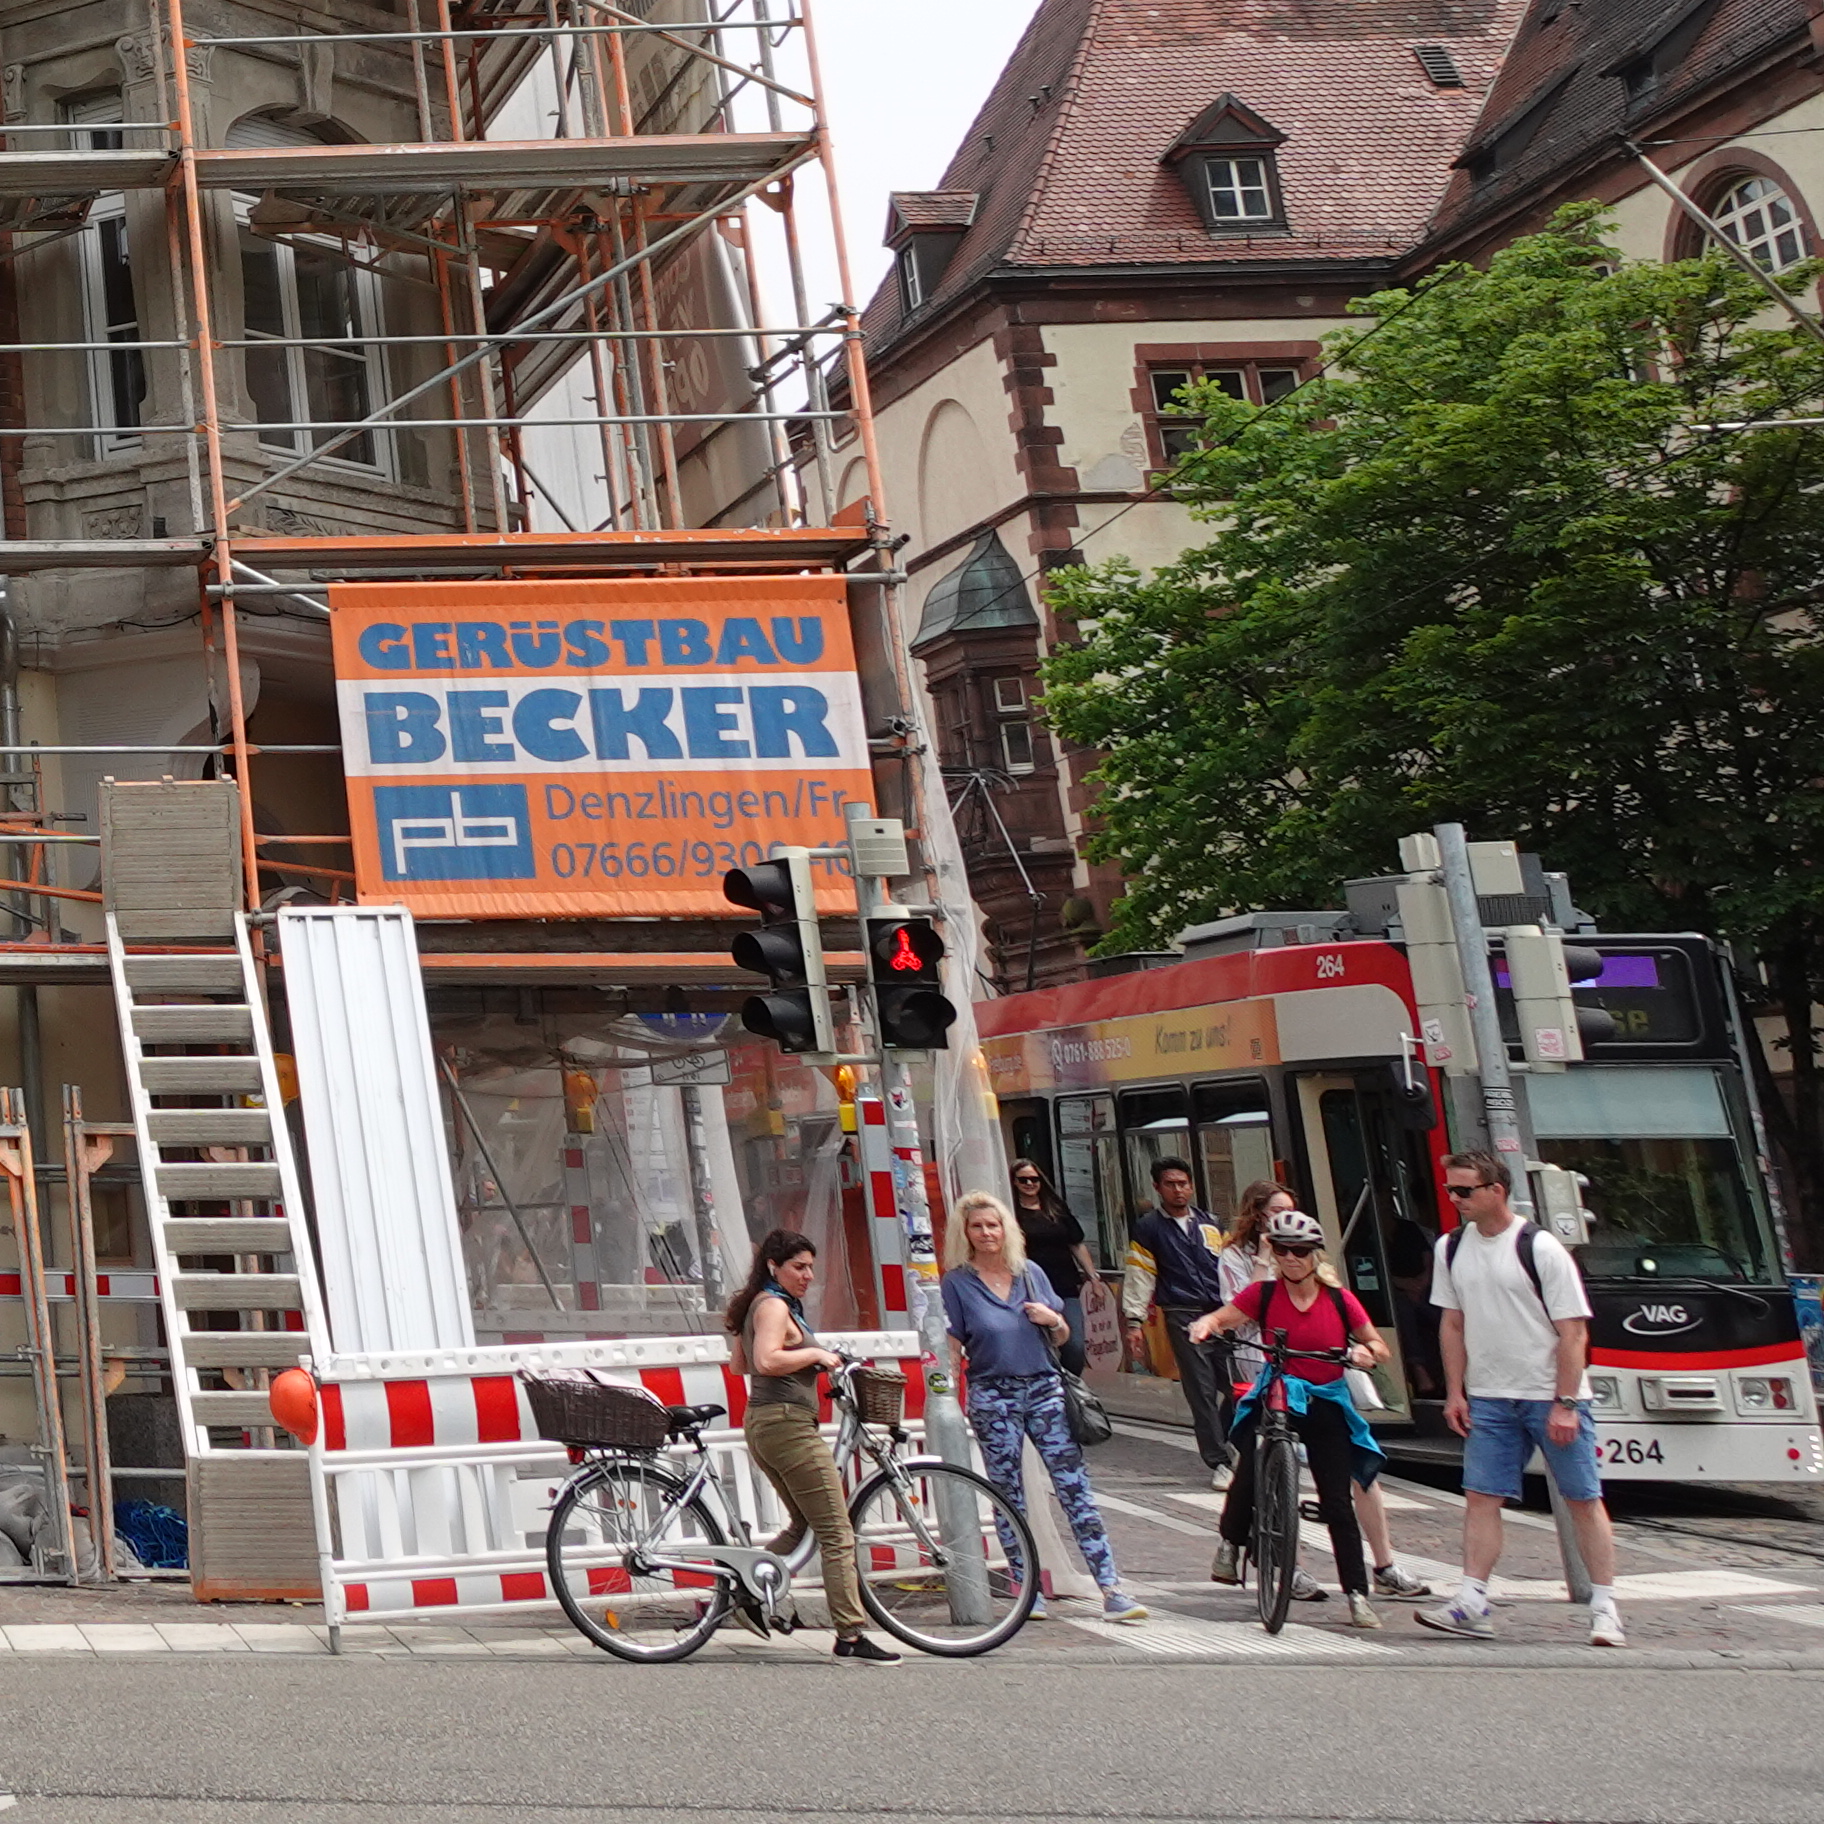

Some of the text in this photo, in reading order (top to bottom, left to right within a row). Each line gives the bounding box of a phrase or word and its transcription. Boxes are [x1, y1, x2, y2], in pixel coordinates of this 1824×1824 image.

[364, 685, 840, 764] BECKER
[551, 839, 850, 878] 07666/930-1
[1316, 954, 1345, 979] 264
[1155, 1025, 1186, 1055] Komm
[1640, 1304, 1688, 1324] VAG
[1606, 1439, 1665, 1465] 264
